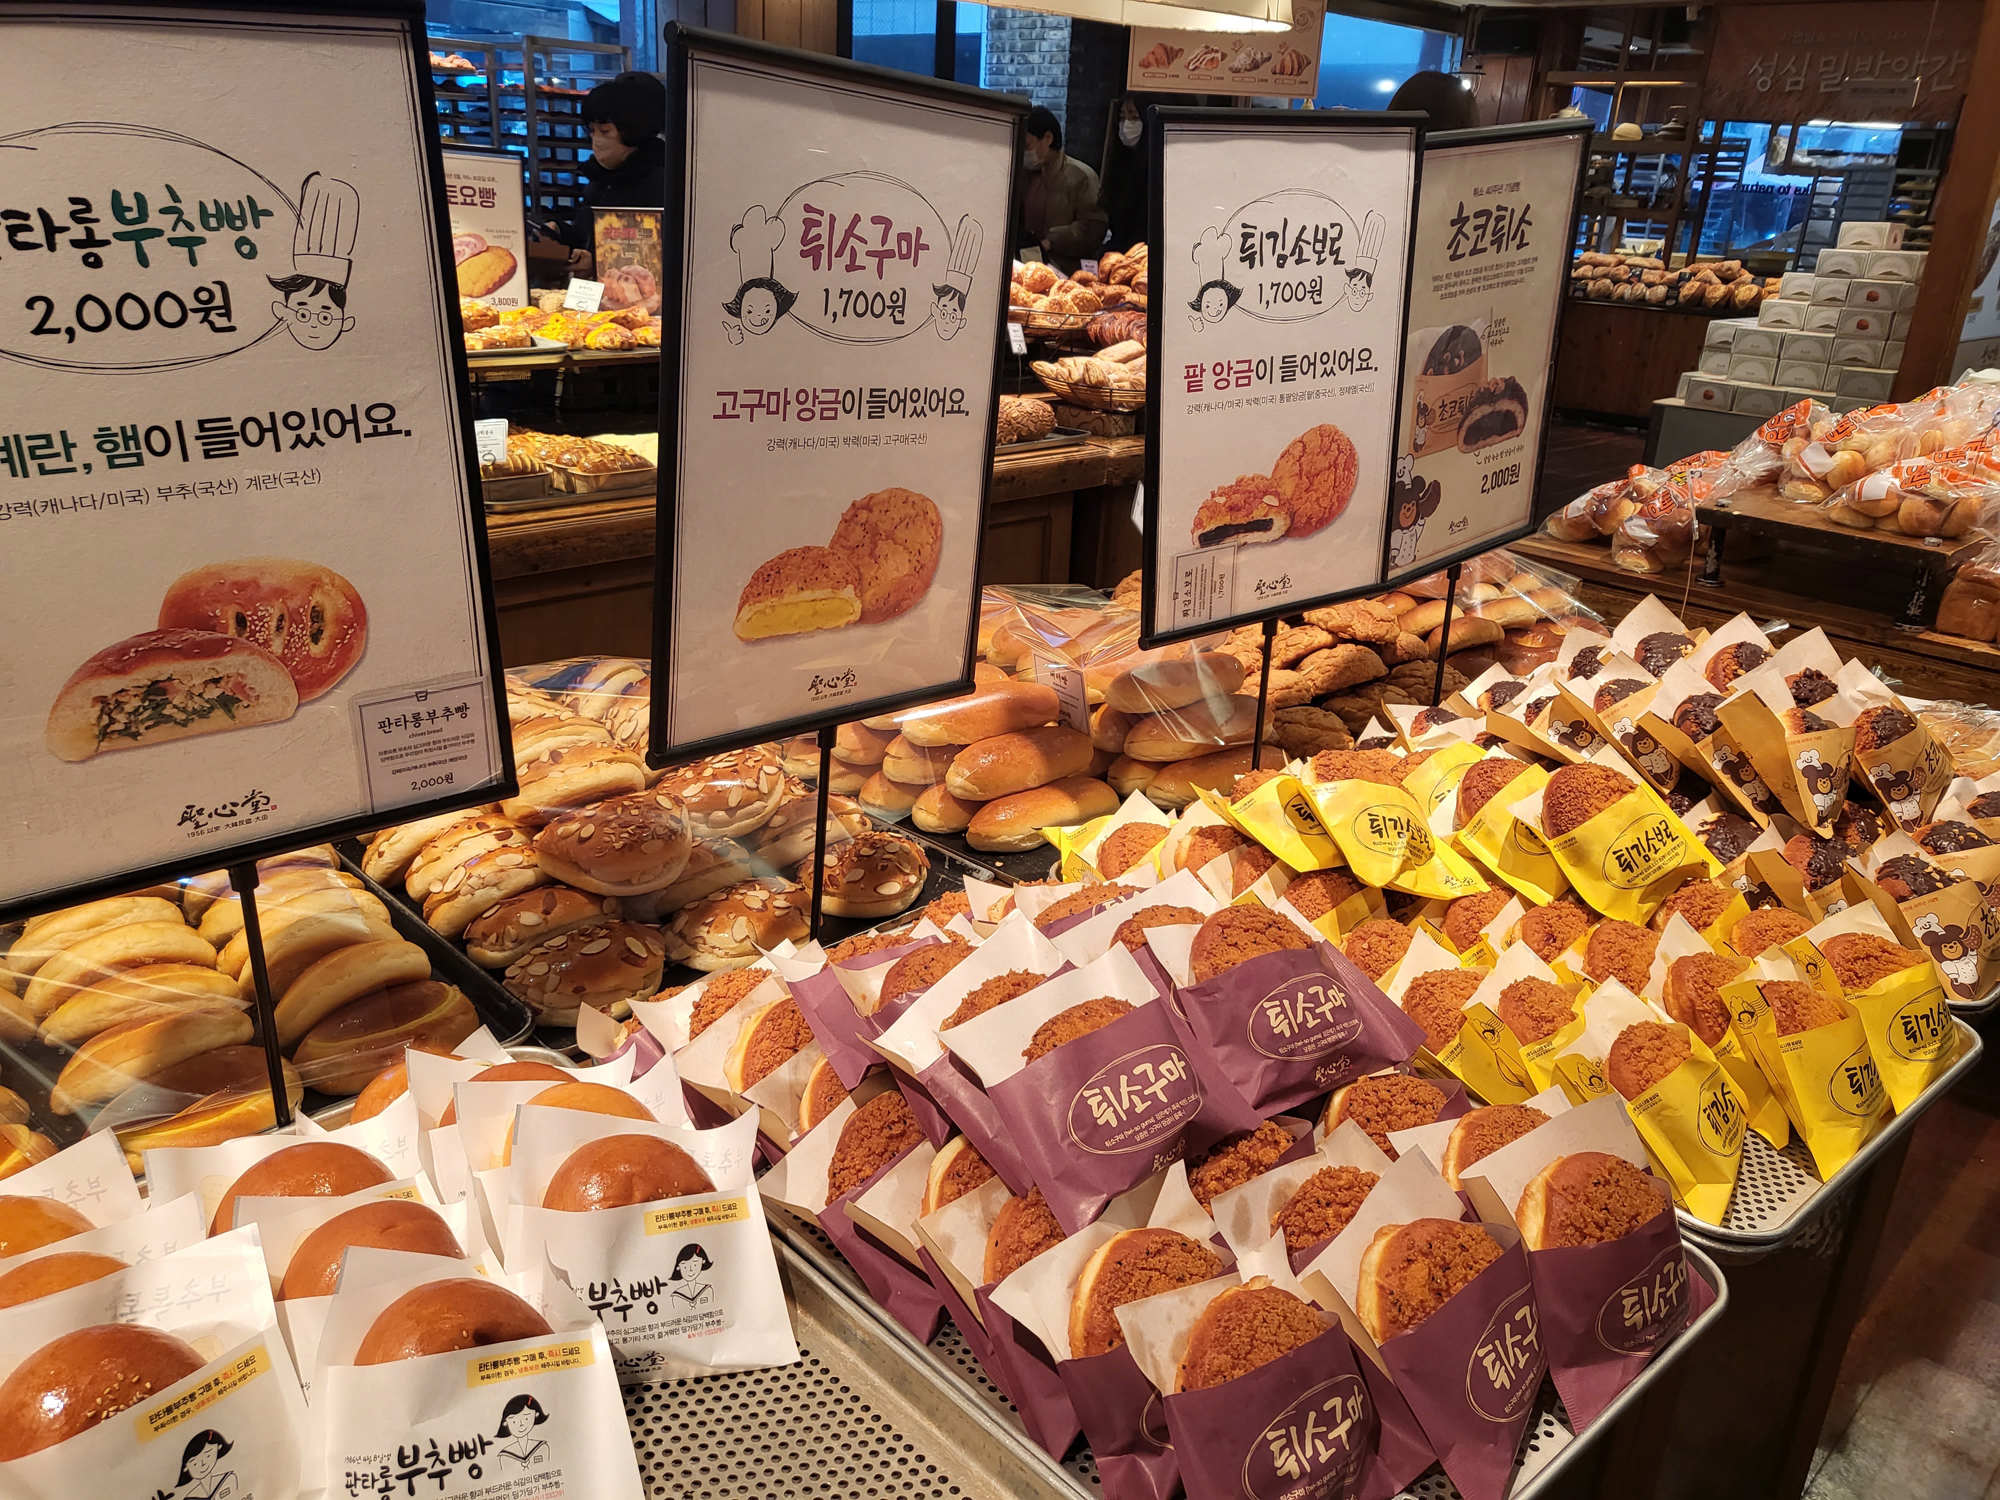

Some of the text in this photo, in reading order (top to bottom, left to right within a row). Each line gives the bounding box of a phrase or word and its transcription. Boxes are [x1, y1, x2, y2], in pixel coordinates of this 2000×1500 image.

[0, 184, 274, 269] 타롱부추빵
[799, 203, 930, 280] 튀소구마
[1239, 217, 1346, 269] 튀김소보로
[1446, 200, 1533, 262] 초코튀소
[25, 280, 237, 344] 2,000원
[823, 287, 907, 325] 1,700원
[1258, 276, 1323, 310] 1,700원
[1184, 347, 1378, 393] 팥 앙금이 들어있어요.
[713, 386, 970, 422] 고구마 앙금이 들어있어요.
[1186, 396, 1244, 415] 강력(캐나다/미국)
[1245, 394, 1277, 407] 박력(미국)
[1438, 390, 1474, 422] 초코튀
[94, 419, 190, 470] 햄이
[194, 402, 412, 460] 들어있어요.
[766, 432, 928, 452] 강력(캐나다/미국) 박력(미국) 고구마(국산)
[156, 476, 239, 503] 부추(국산)
[245, 467, 322, 493] 계란(국산)
[1480, 462, 1521, 494] 2,000원
[377, 702, 470, 734] 판타롱부추빵
[409, 727, 443, 739] chives bread
[411, 772, 454, 792] 2,000원
[177, 789, 271, 830] 聖心堂
[187, 830, 206, 838] 1956
[1367, 813, 1431, 851] 튀김소보로
[1612, 819, 1679, 873] 튀김소보로
[1263, 984, 1346, 1038] 튀소구마
[1083, 1052, 1187, 1128] 튀소구마
[722, 1202, 738, 1212] 드세요
[588, 1276, 668, 1322] 부추빵
[623, 1325, 647, 1336] 싱그러운
[648, 1322, 660, 1331] 향과
[660, 1318, 682, 1329] 부드러운
[478, 1356, 520, 1373] 판타롱부추빵
[522, 1353, 536, 1363] 구매
[548, 1349, 561, 1358] 즉시
[562, 1346, 581, 1356] 드세요
[1477, 1305, 1539, 1389] 튀소구
[148, 1391, 197, 1424] 판타롱부추빵
[197, 1382, 213, 1396] 구매
[222, 1367, 237, 1380] 즉시
[236, 1354, 257, 1373] 드세요
[1266, 1385, 1363, 1479] 튀소구마
[396, 1433, 494, 1497] 부추빵
[469, 1469, 563, 1499] 향과 부드러운 식감의 담백함으로
